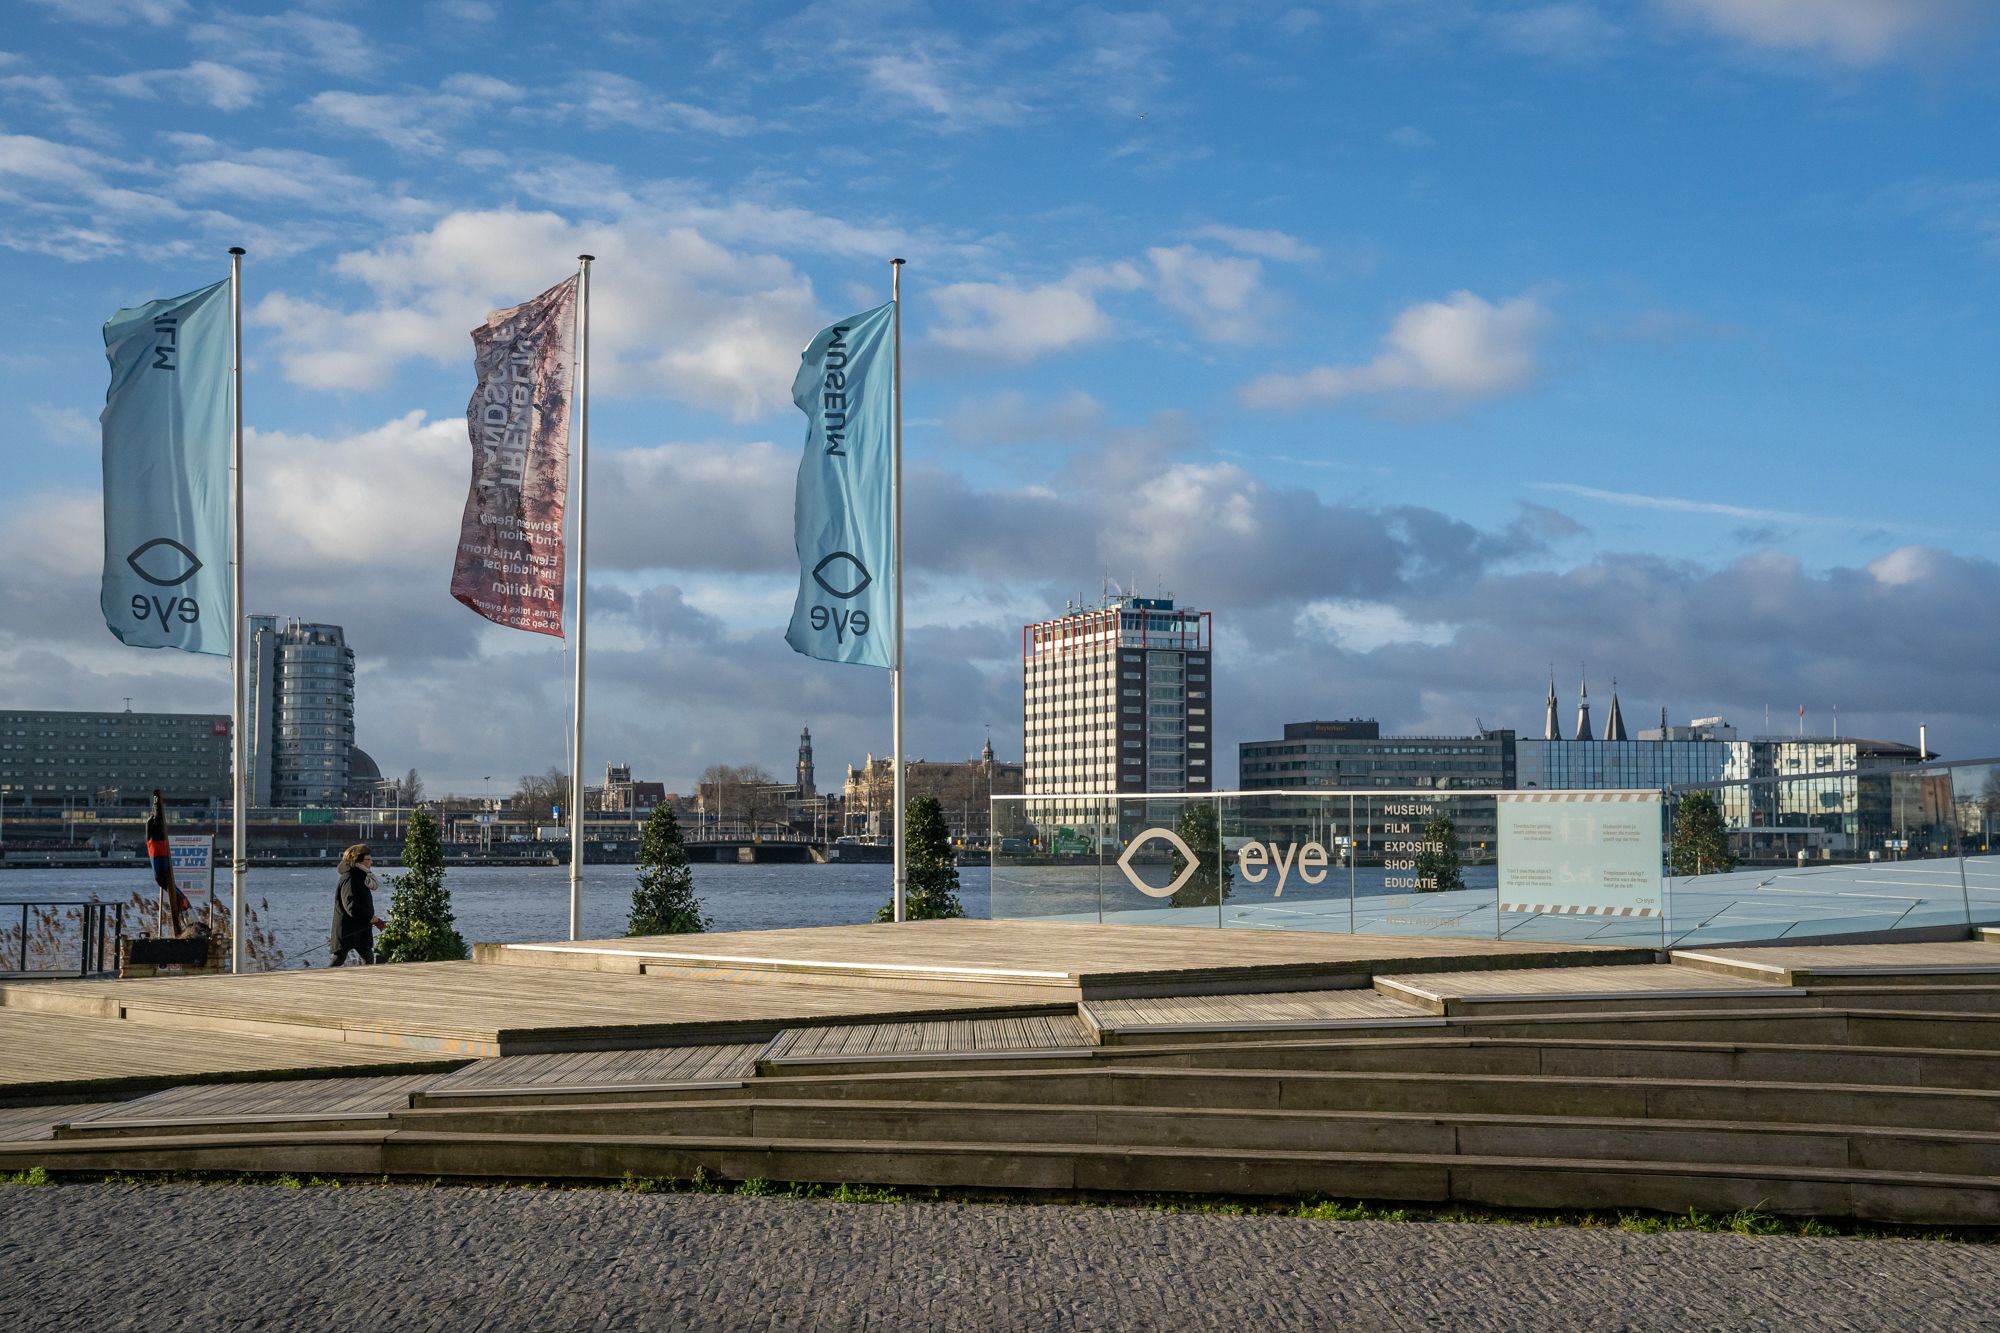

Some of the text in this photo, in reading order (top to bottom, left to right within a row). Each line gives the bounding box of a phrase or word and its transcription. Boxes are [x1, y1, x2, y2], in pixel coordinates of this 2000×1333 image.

[1384, 804, 1432, 816] MUSEUM
[1384, 823, 1410, 834] FILM
[1384, 841, 1443, 853] EXPOSITIE
[1239, 841, 1328, 897] eye
[1384, 860, 1415, 870] SHOP
[1384, 877, 1438, 889] EDUCATIE
